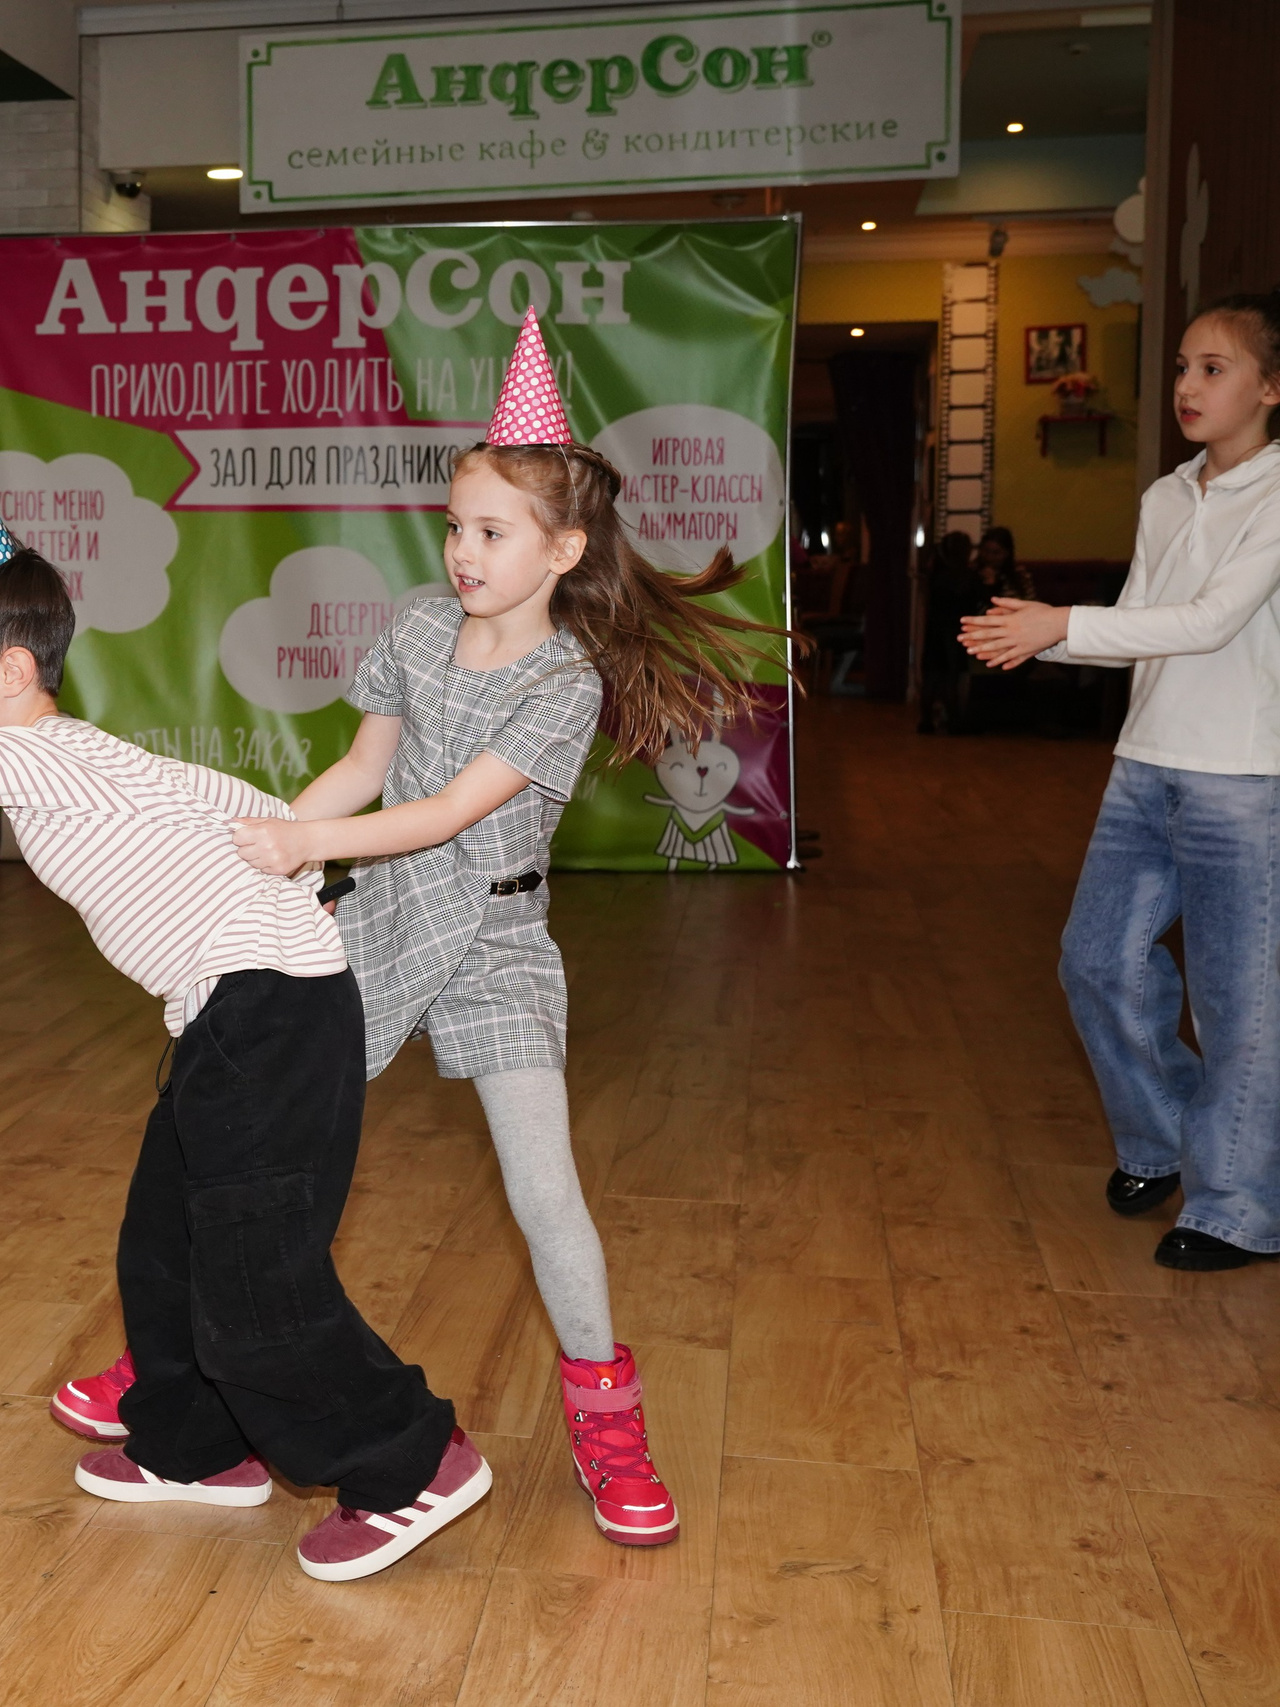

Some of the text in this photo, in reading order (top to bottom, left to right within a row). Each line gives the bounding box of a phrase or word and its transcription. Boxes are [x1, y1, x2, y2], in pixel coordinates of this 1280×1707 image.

[287, 119, 899, 170] семейные кафе & кондитерские
[90, 359, 270, 419] ПРИХОДИТЕ
[282, 357, 404, 421] ХОДИТЬ
[416, 357, 458, 412] НА
[210, 442, 459, 489] ЗАЛ ДЛЯ ПРАЗДНИКО
[652, 437, 726, 466] ИГРОВАЯ
[53, 489, 105, 521] МЕНЮ
[618, 474, 763, 504] МАСТЕР-КЛАССЫ
[638, 511, 738, 541] АНИМАТОРЫ
[87, 531, 99, 561] И
[276, 639, 346, 680] РУЧНОЙ
[190, 725, 224, 767] НА
